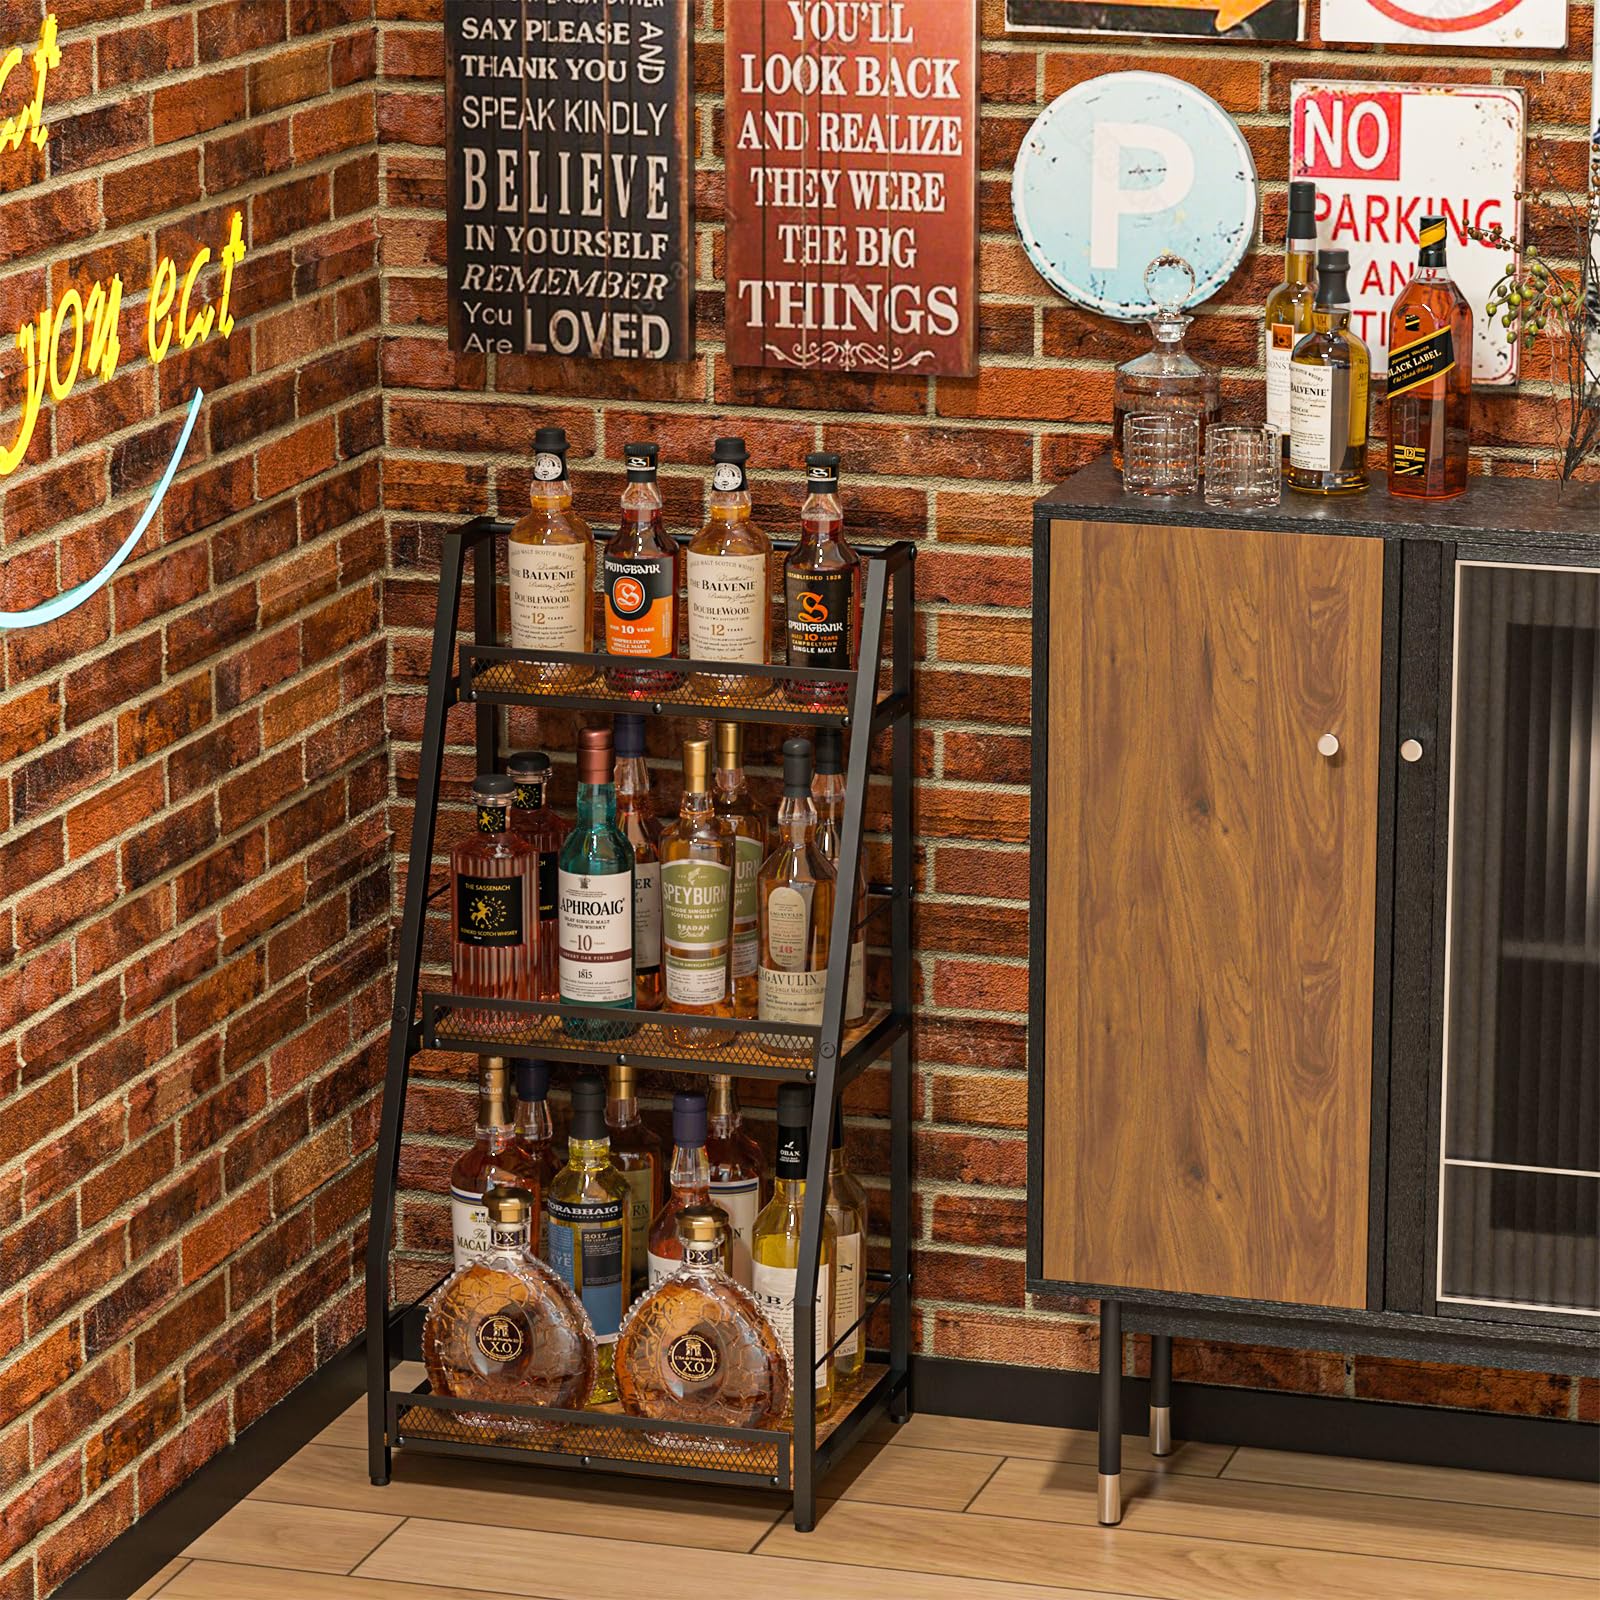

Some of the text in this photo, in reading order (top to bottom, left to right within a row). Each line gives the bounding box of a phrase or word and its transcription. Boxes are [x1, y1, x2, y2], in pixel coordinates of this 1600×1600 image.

[462, 17, 631, 45] SAY PLEASE
[787, 0, 914, 43] YOU'LL
[637, 21, 666, 84] AND
[460, 54, 627, 82] THANK YOU
[740, 53, 961, 99] LOOK BACK
[462, 96, 668, 137] SPEAK KINDLY
[737, 110, 962, 156] AND REALIZE
[1303, 97, 1390, 171] NO
[463, 147, 669, 220] BELIEVE
[750, 167, 945, 213] THEY WERE
[1090, 120, 1195, 270] P
[464, 224, 669, 260] IN YOURSELF
[778, 224, 917, 269] THE BIG
[460, 263, 669, 301] REMEMBER
[1360, 260, 1416, 297] AN
[463, 301, 513, 326] You
[738, 279, 960, 336] THINGS
[463, 308, 670, 359] Are LOVED
[1413, 349, 1442, 366] LABEL
[522, 568, 576, 580] BALVENIE
[702, 579, 756, 592] BALVENIE
[531, 612, 545, 625] 12
[621, 625, 635, 635] 10
[711, 624, 725, 636] 12
[804, 633, 819, 641] 10
[560, 897, 624, 916] APHROAIG
[664, 882, 727, 905] SPEYBURN
[577, 934, 592, 951] 10
[578, 971, 593, 979] 1815
[457, 1235, 489, 1251] MACAL
[473, 1229, 487, 1240] The
